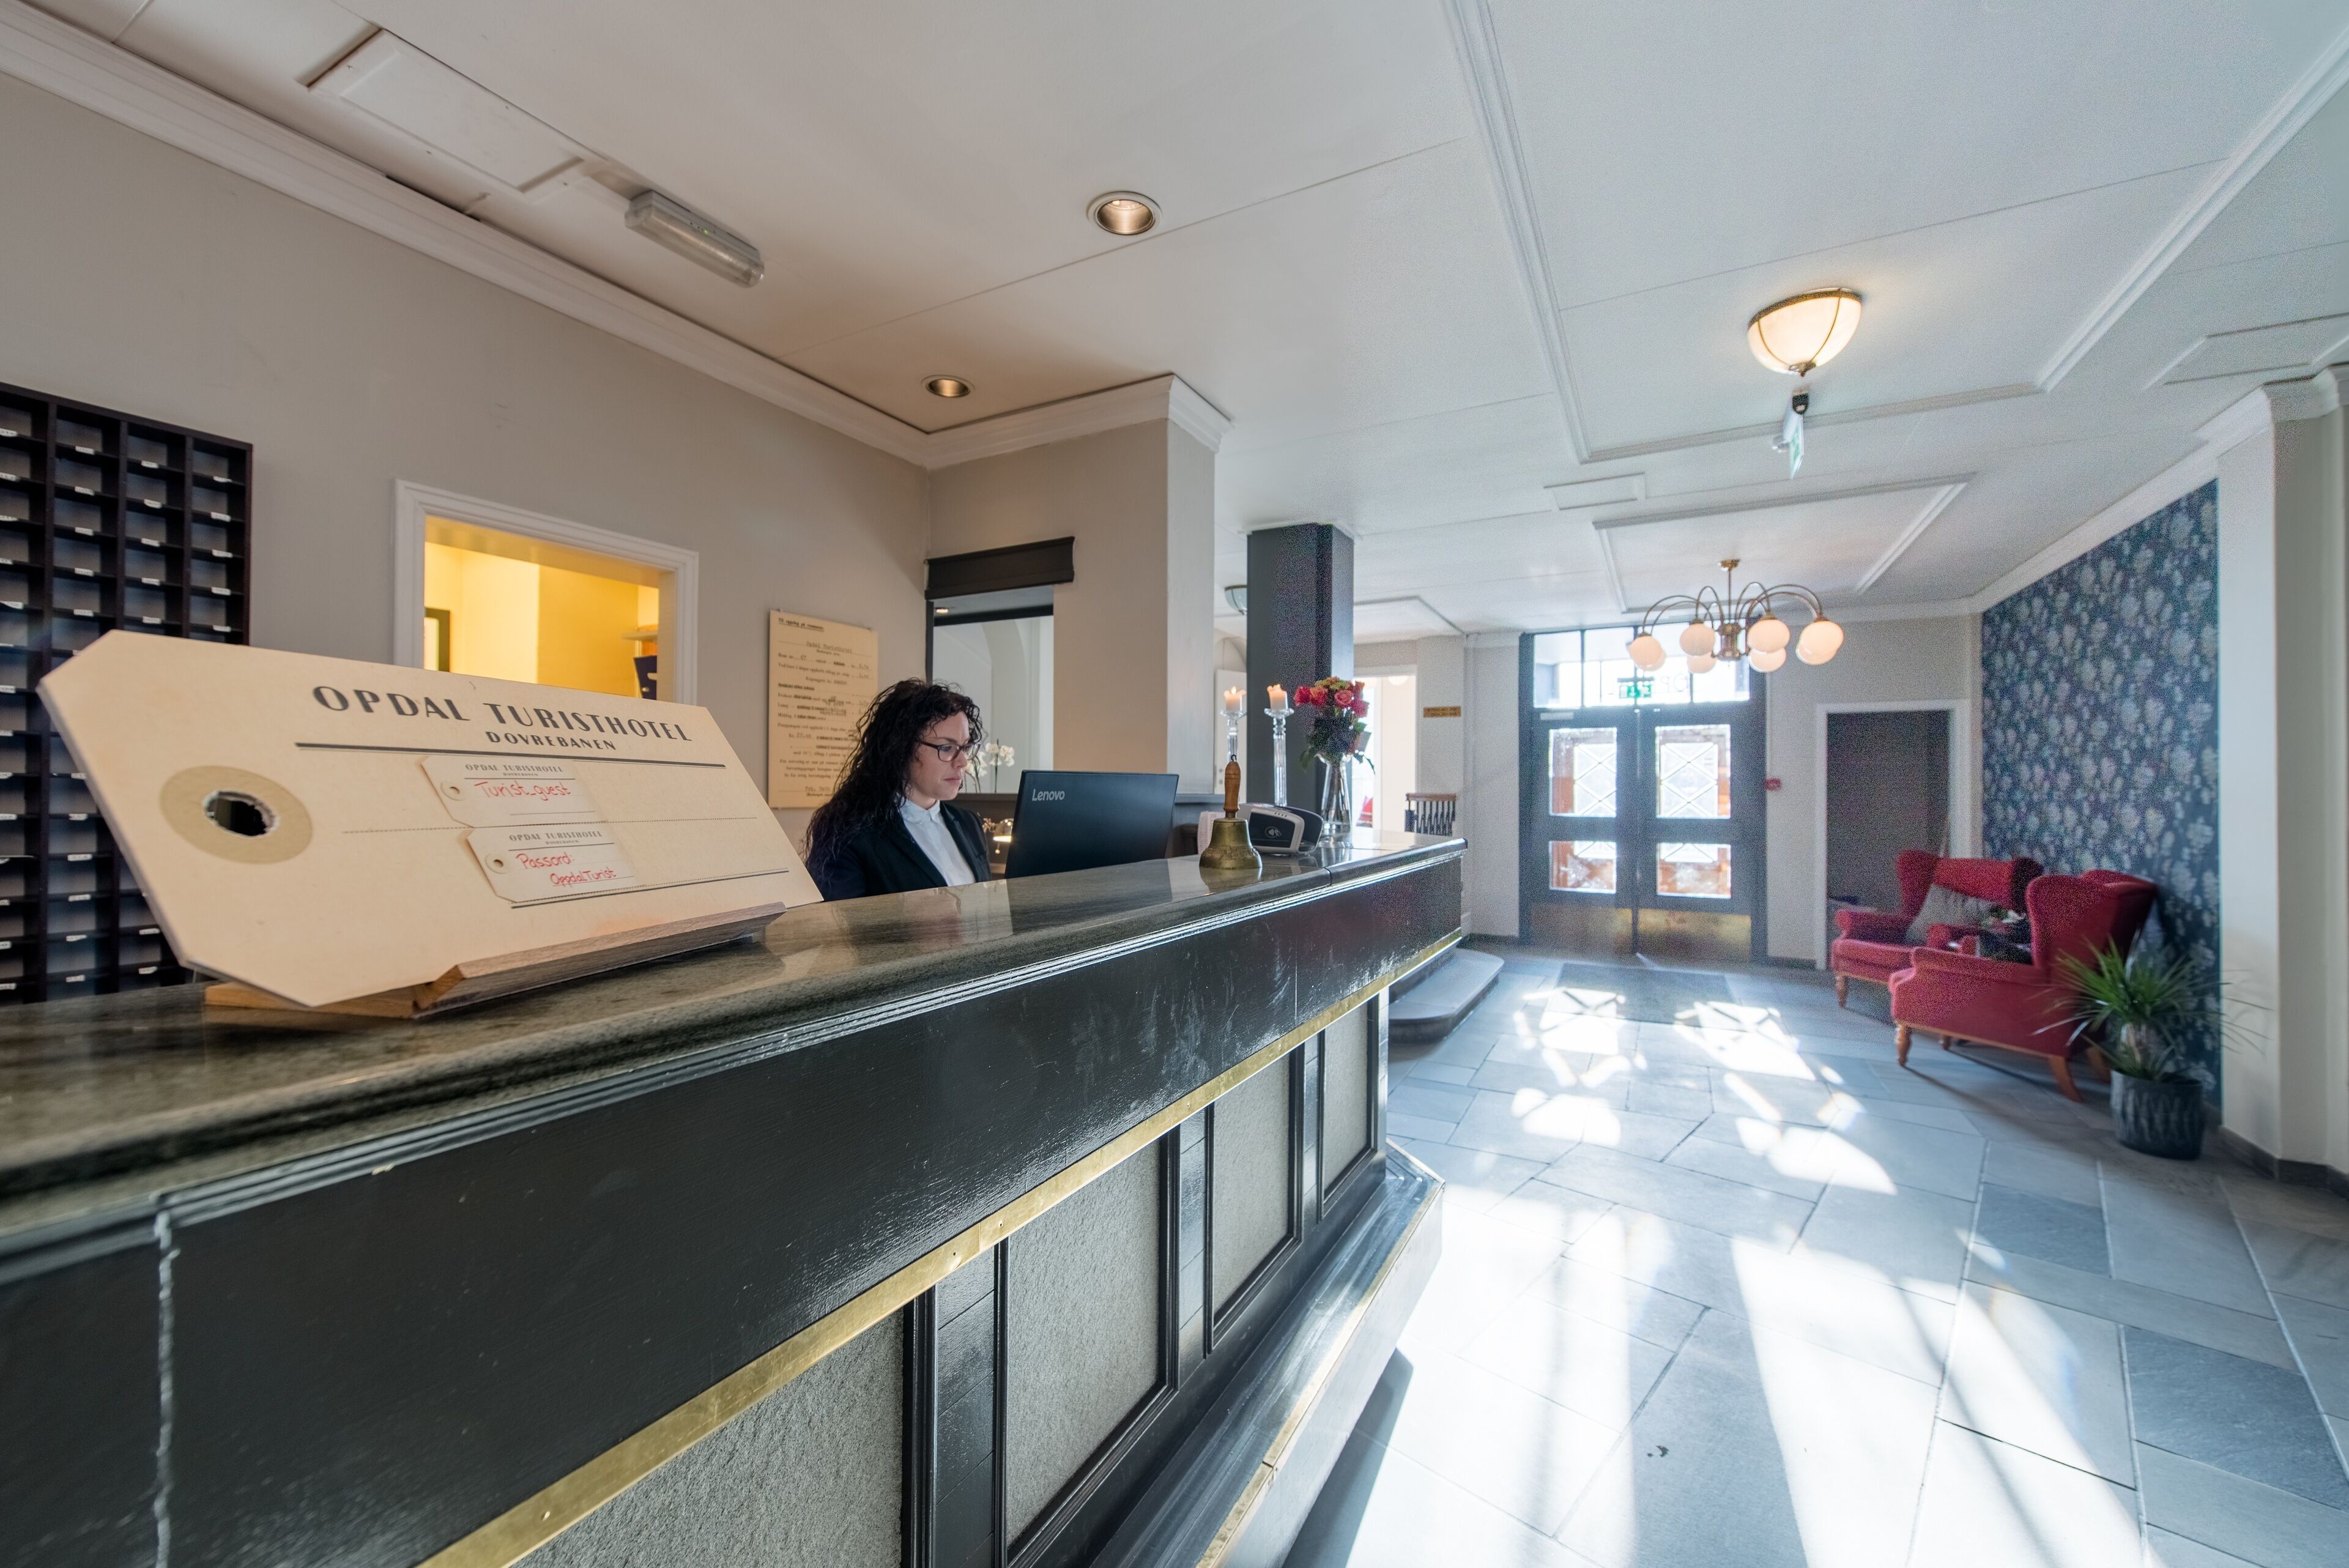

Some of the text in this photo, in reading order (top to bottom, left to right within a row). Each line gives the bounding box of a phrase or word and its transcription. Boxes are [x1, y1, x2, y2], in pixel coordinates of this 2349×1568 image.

[313, 685, 692, 743] OPDAL TURISTHOTEL
[486, 731, 617, 751] DOVREBANEN
[502, 764, 564, 773] TURISTHOTEL
[1032, 789, 1065, 801] Lenovo
[509, 831, 603, 842] OPDAL TURISTHOTEL
[516, 851, 576, 869] Passord:
